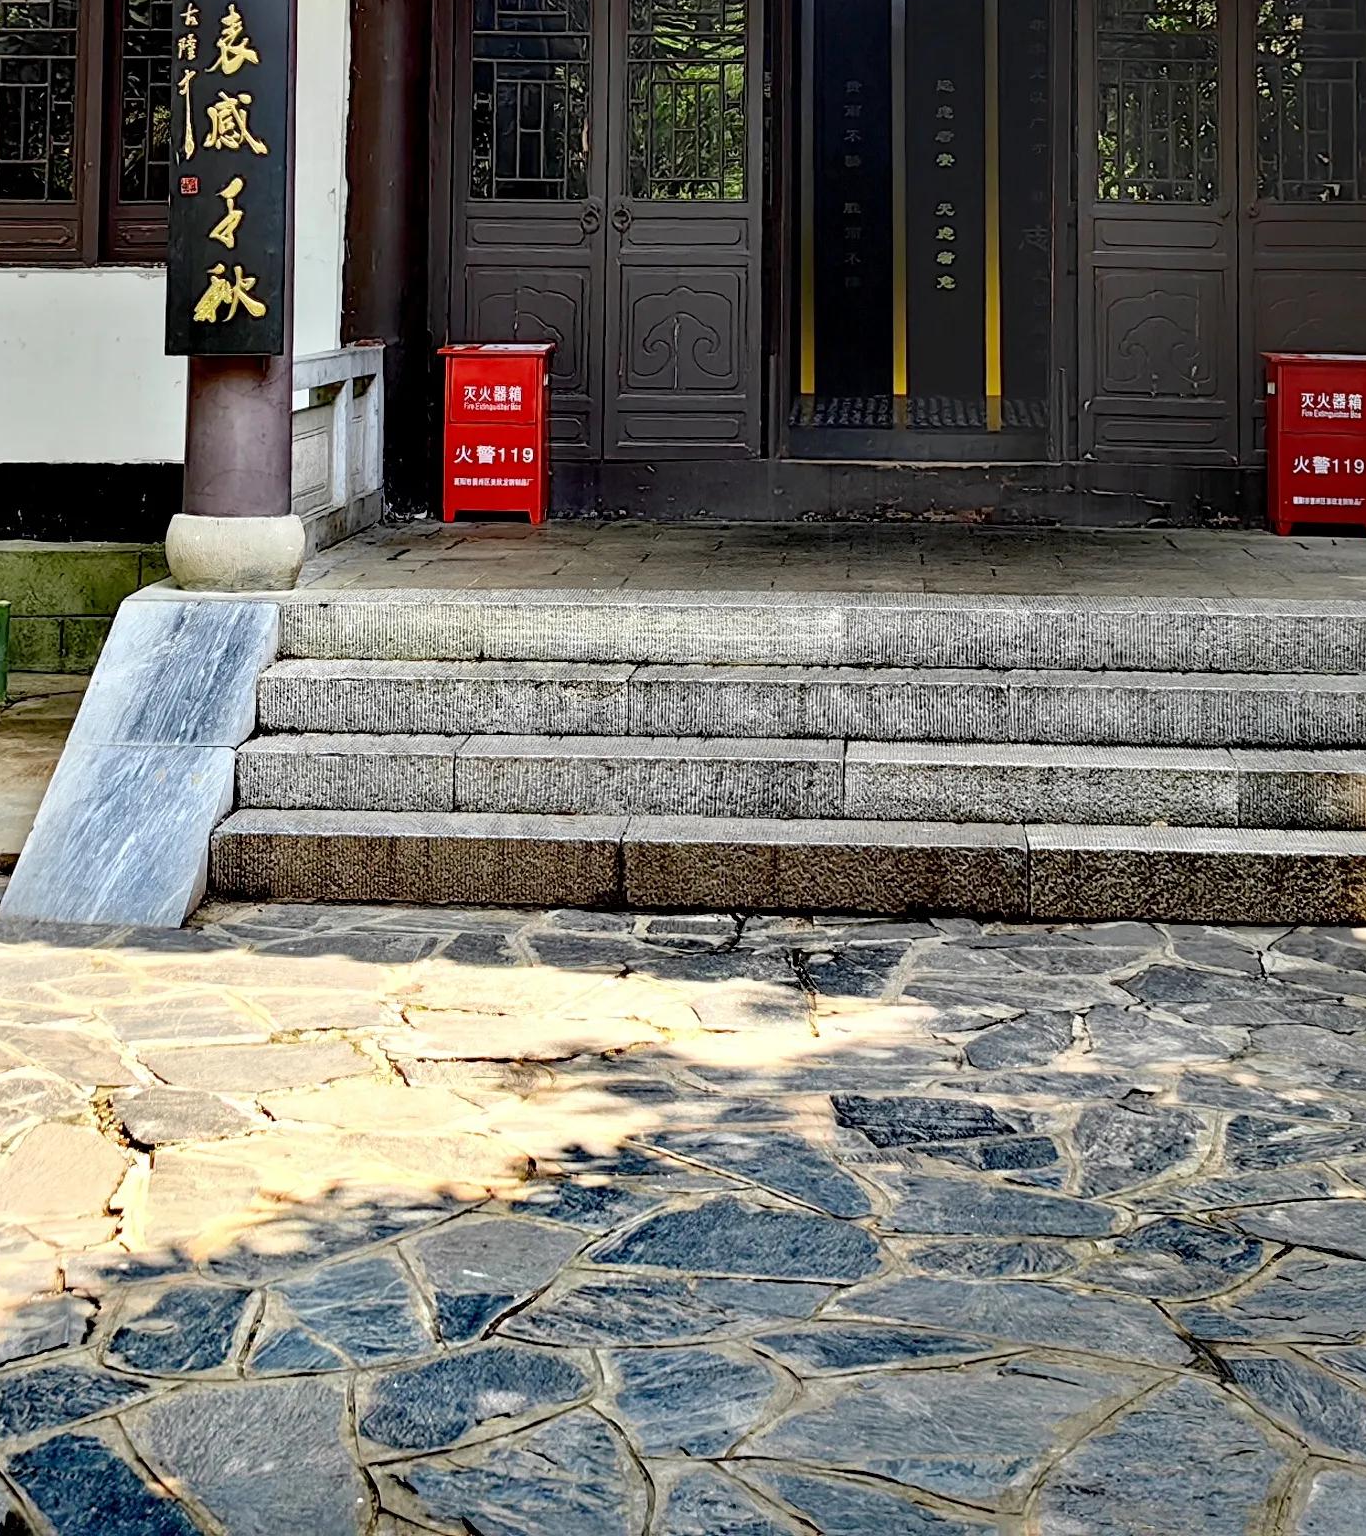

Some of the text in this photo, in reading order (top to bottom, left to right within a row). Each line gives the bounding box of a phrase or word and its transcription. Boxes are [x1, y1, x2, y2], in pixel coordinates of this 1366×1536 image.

[463, 385, 522, 402] 灭火器箱
[1300, 393, 1363, 411] 灭火器箱
[453, 445, 534, 465] 火警119
[1292, 455, 1365, 475] 火警119
